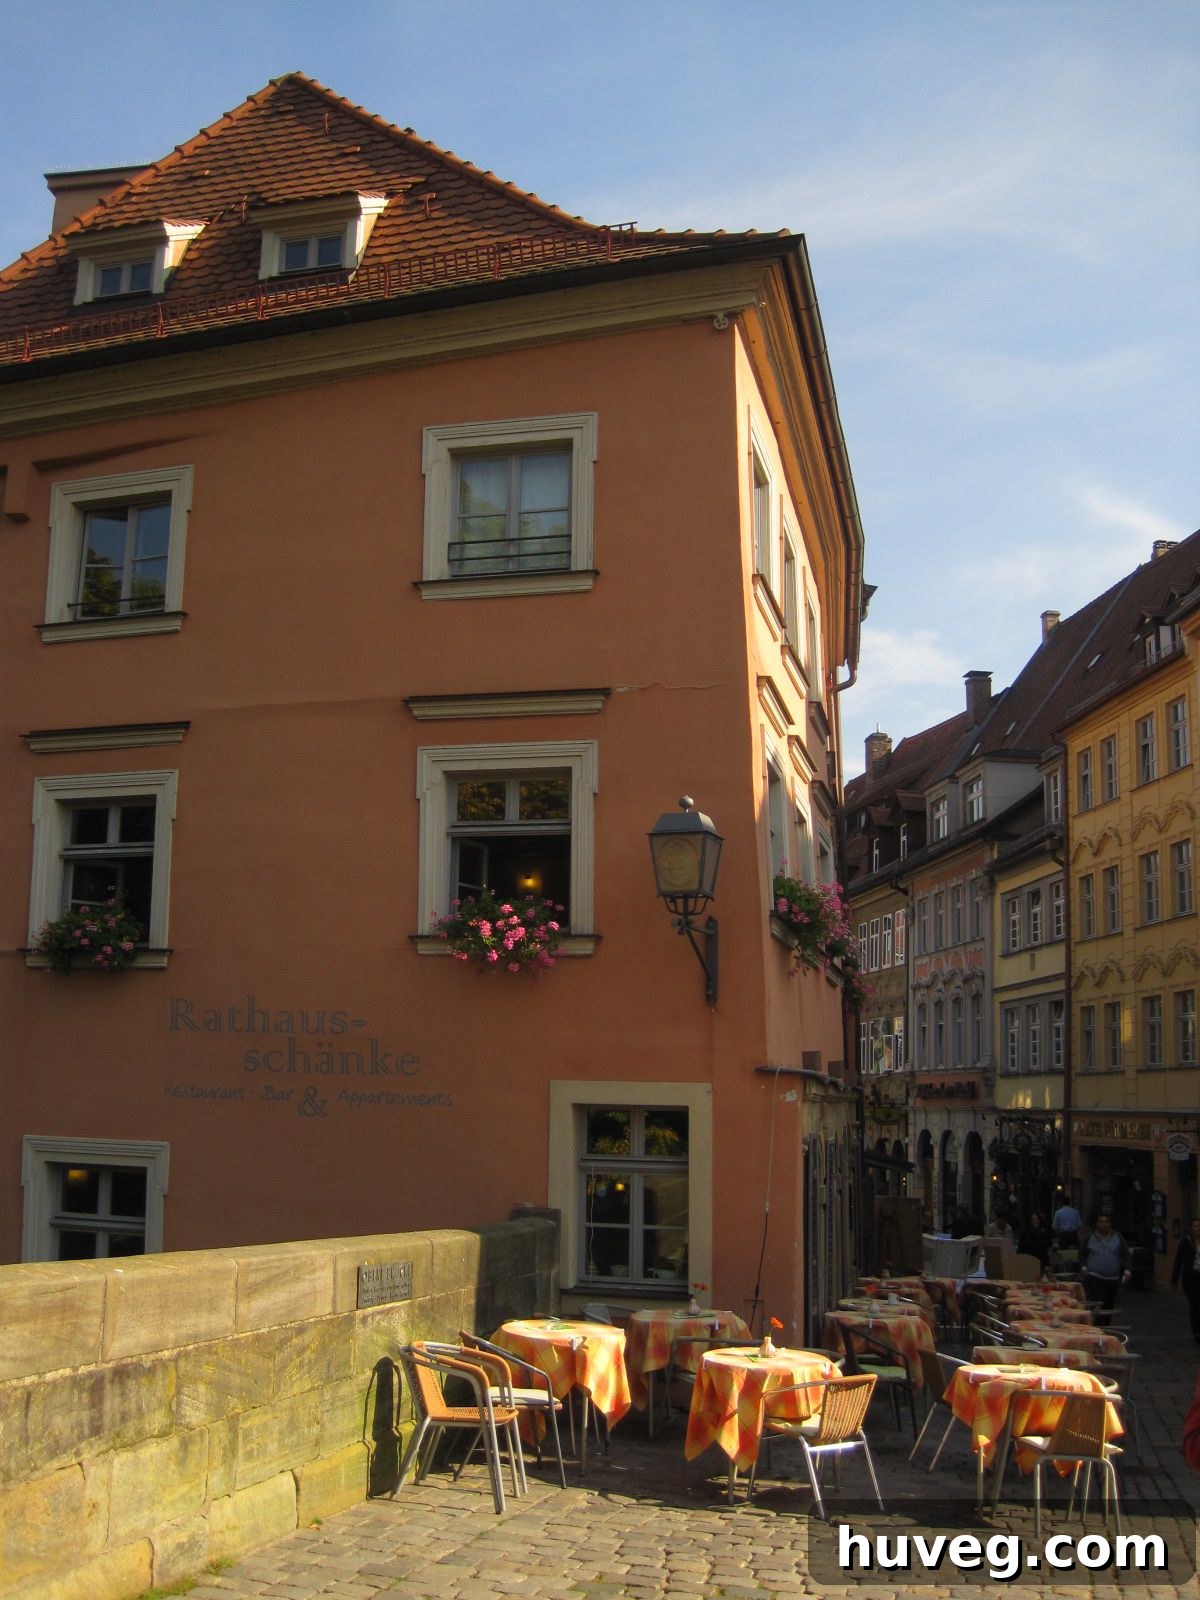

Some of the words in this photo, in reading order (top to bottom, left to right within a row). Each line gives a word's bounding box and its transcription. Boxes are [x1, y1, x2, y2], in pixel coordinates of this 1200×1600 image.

[242, 1037, 421, 1076] schänke
[164, 1081, 246, 1100] Restaurant
[261, 1085, 294, 1102] Bar
[297, 1086, 329, 1118] &
[337, 1089, 454, 1108] Appartements
